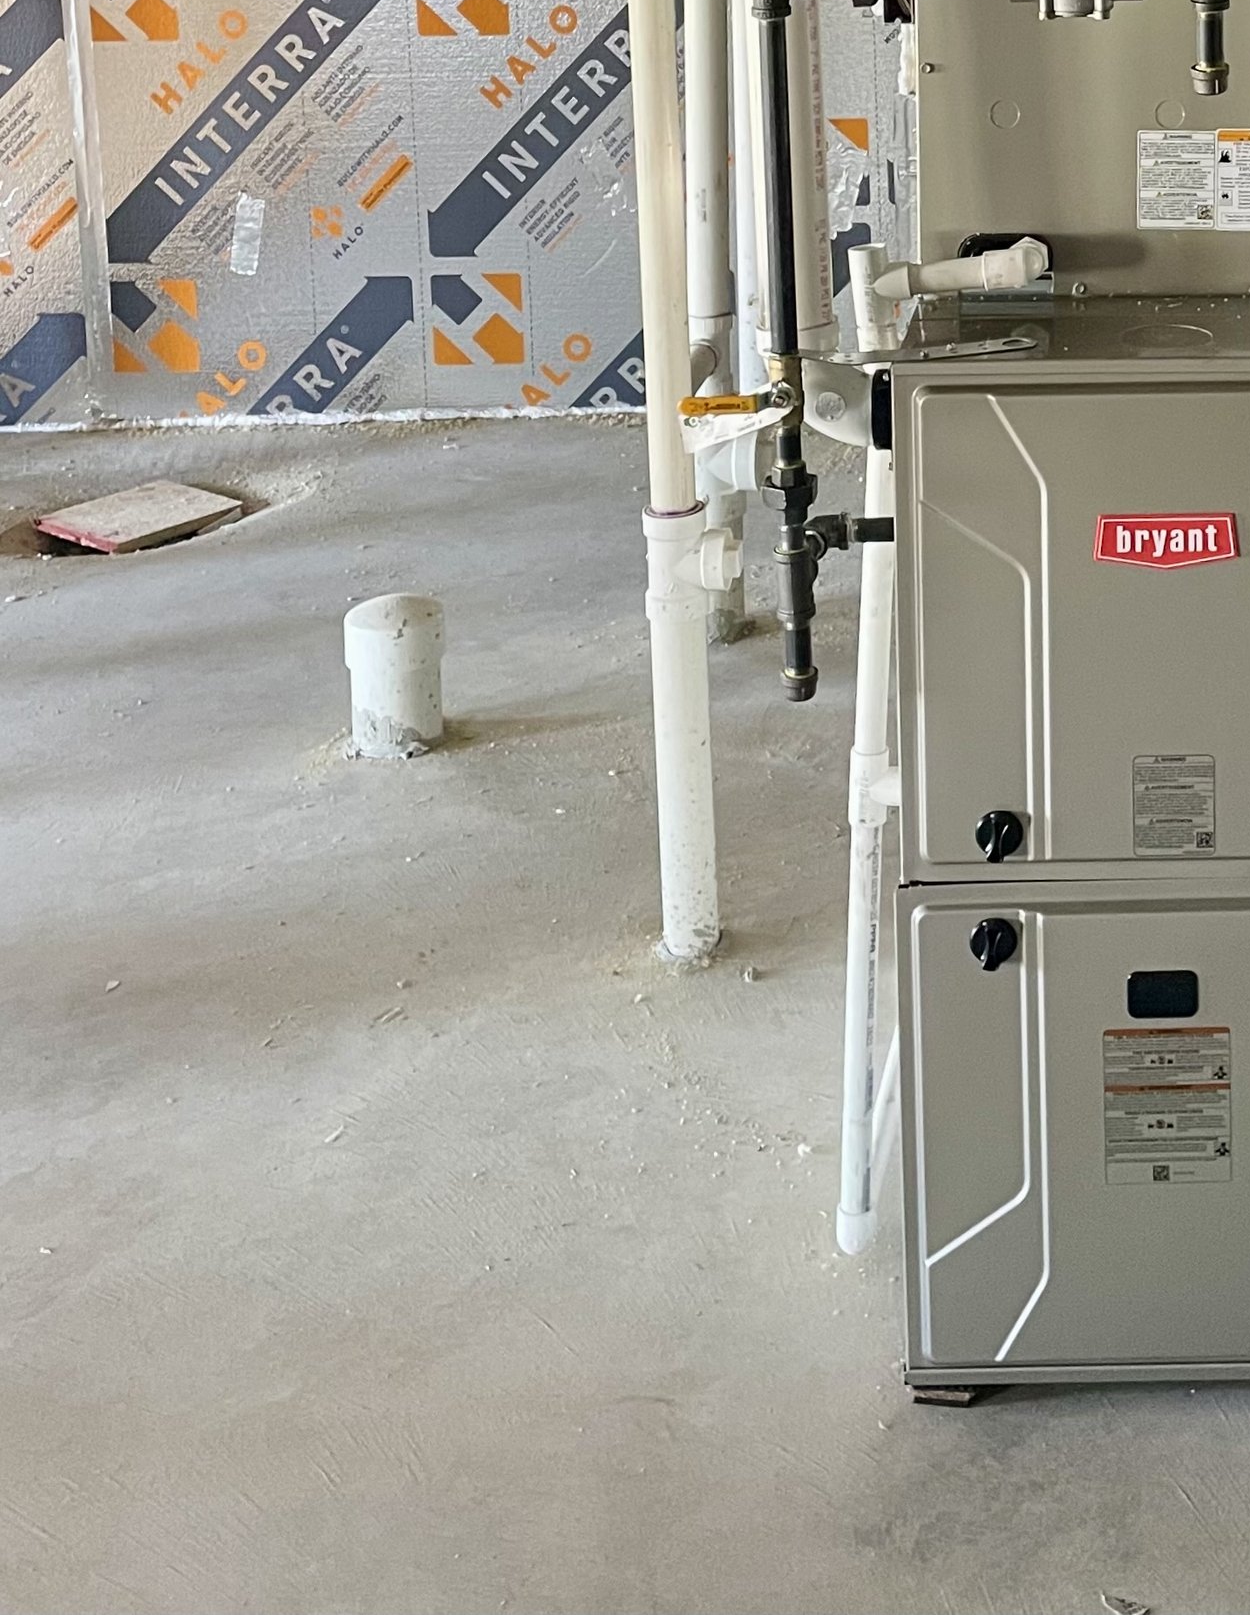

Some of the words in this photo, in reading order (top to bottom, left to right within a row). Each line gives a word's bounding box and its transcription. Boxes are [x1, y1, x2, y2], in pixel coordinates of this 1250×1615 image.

[150, 8, 248, 115] HALO
[480, 4, 578, 109] HALO
[155, 7, 346, 205] INTERRA
[3, 264, 35, 297] HALO
[332, 226, 364, 261] HALO
[179, 341, 267, 419] ALO
[505, 333, 592, 409] ALO
[1116, 522, 1218, 559] bryant
